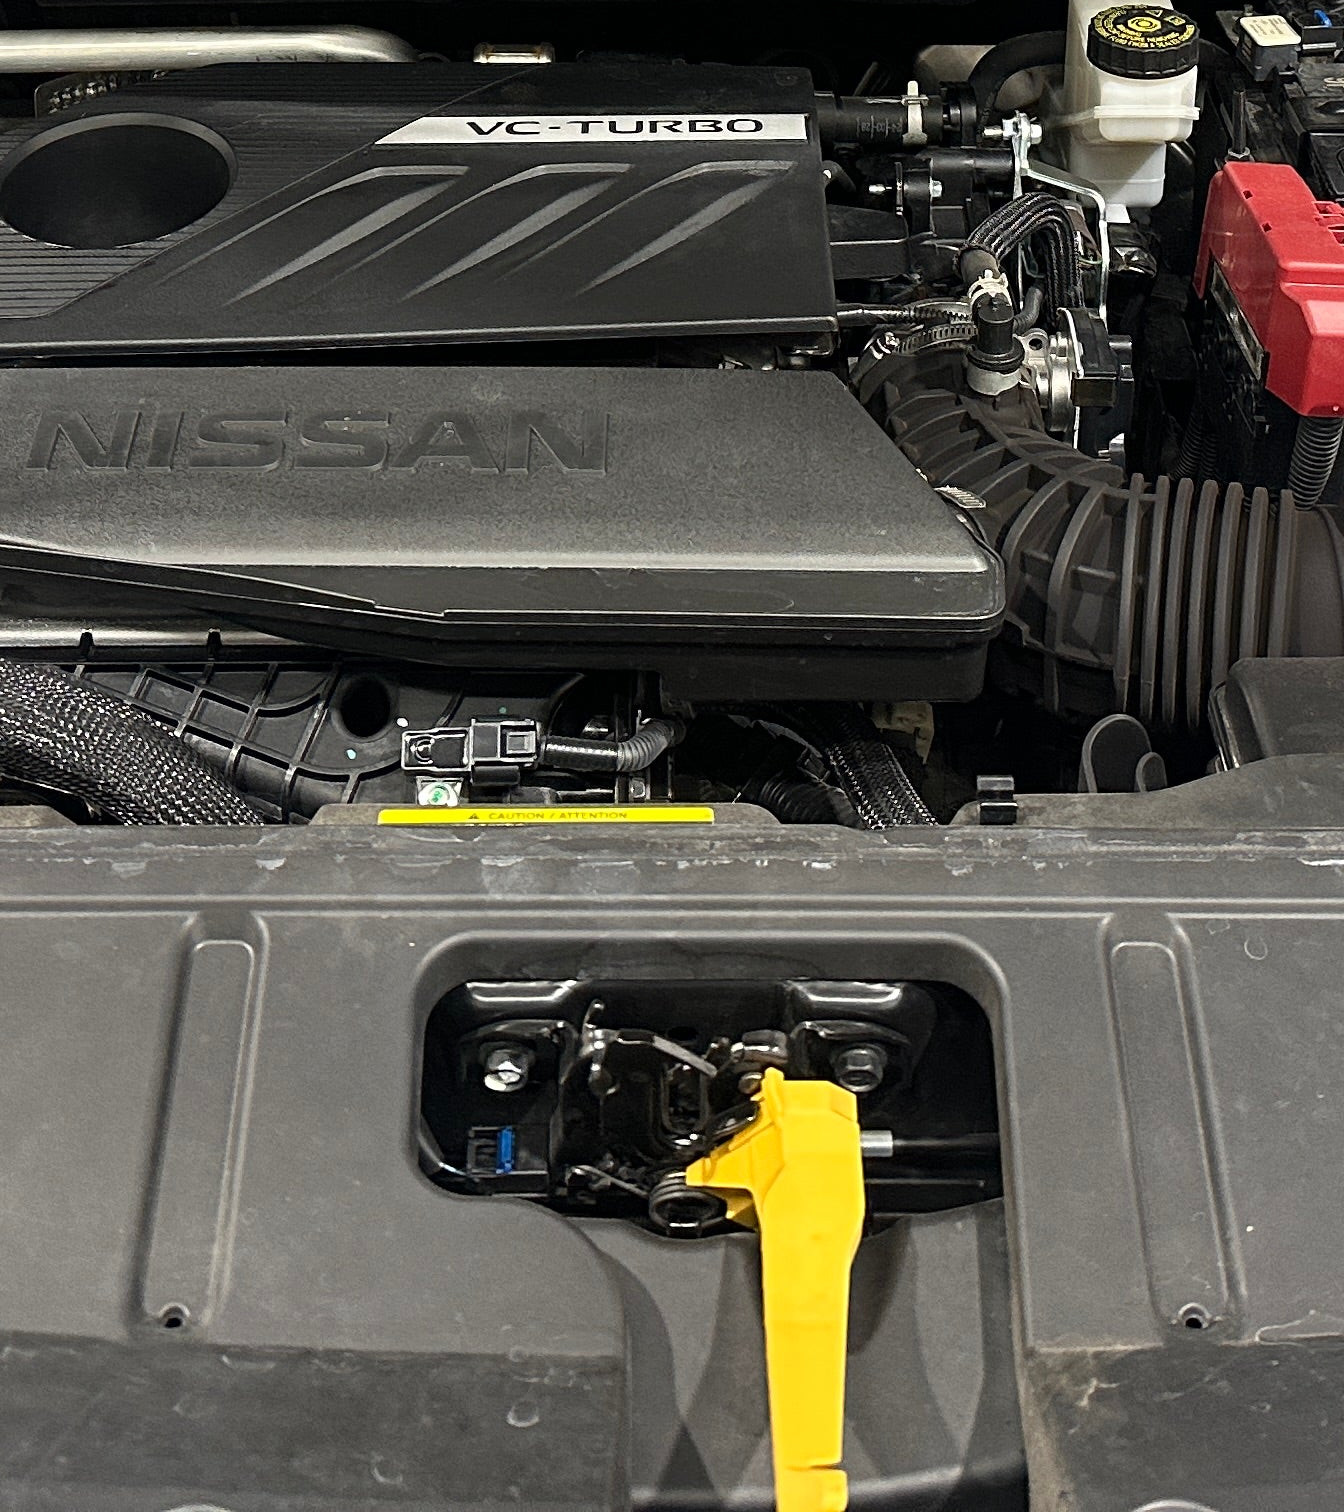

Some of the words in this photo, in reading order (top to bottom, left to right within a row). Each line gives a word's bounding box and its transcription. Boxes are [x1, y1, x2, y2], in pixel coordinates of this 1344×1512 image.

[465, 118, 764, 136] VC-TURBO
[25, 409, 610, 475] NISSAN
[488, 811, 545, 820] CAUTION
[558, 811, 628, 819] ATTENTION
